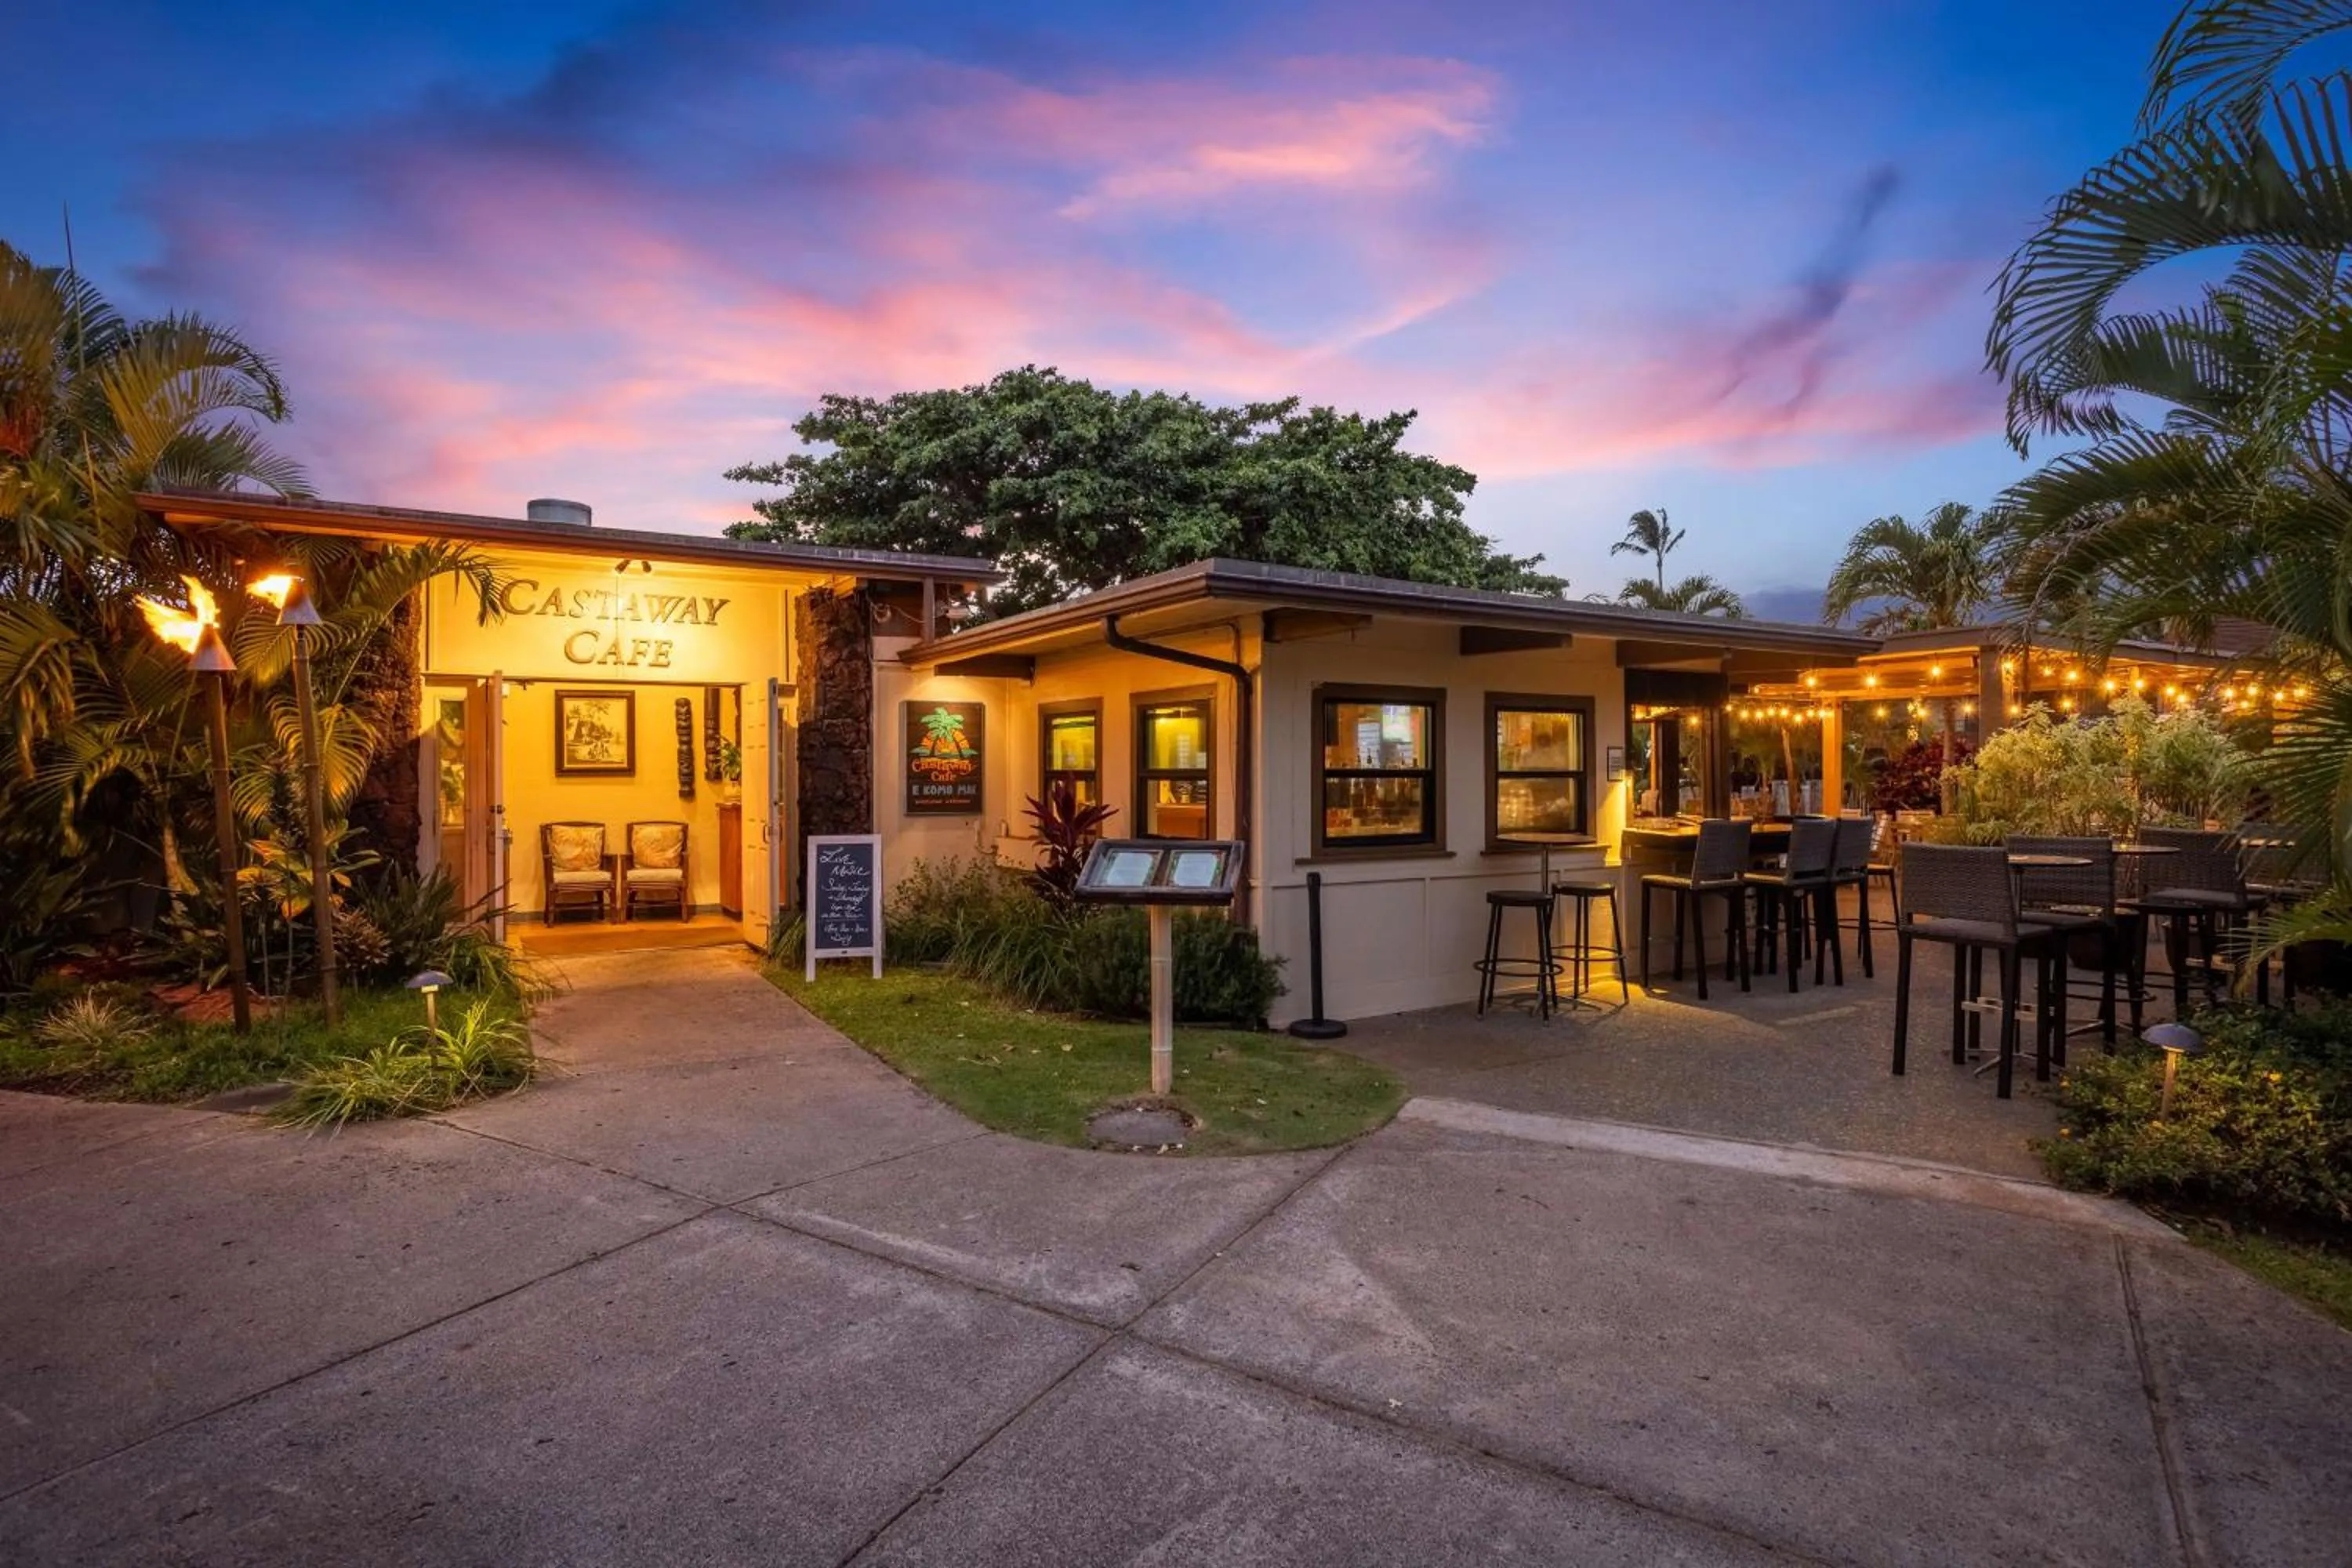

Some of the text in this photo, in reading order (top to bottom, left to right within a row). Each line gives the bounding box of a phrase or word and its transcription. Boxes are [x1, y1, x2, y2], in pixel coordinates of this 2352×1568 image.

[499, 578, 731, 626] CASTAWAY
[564, 630, 674, 668] CAFE
[911, 758, 975, 775] Castaway
[923, 784, 953, 797] KOMO
